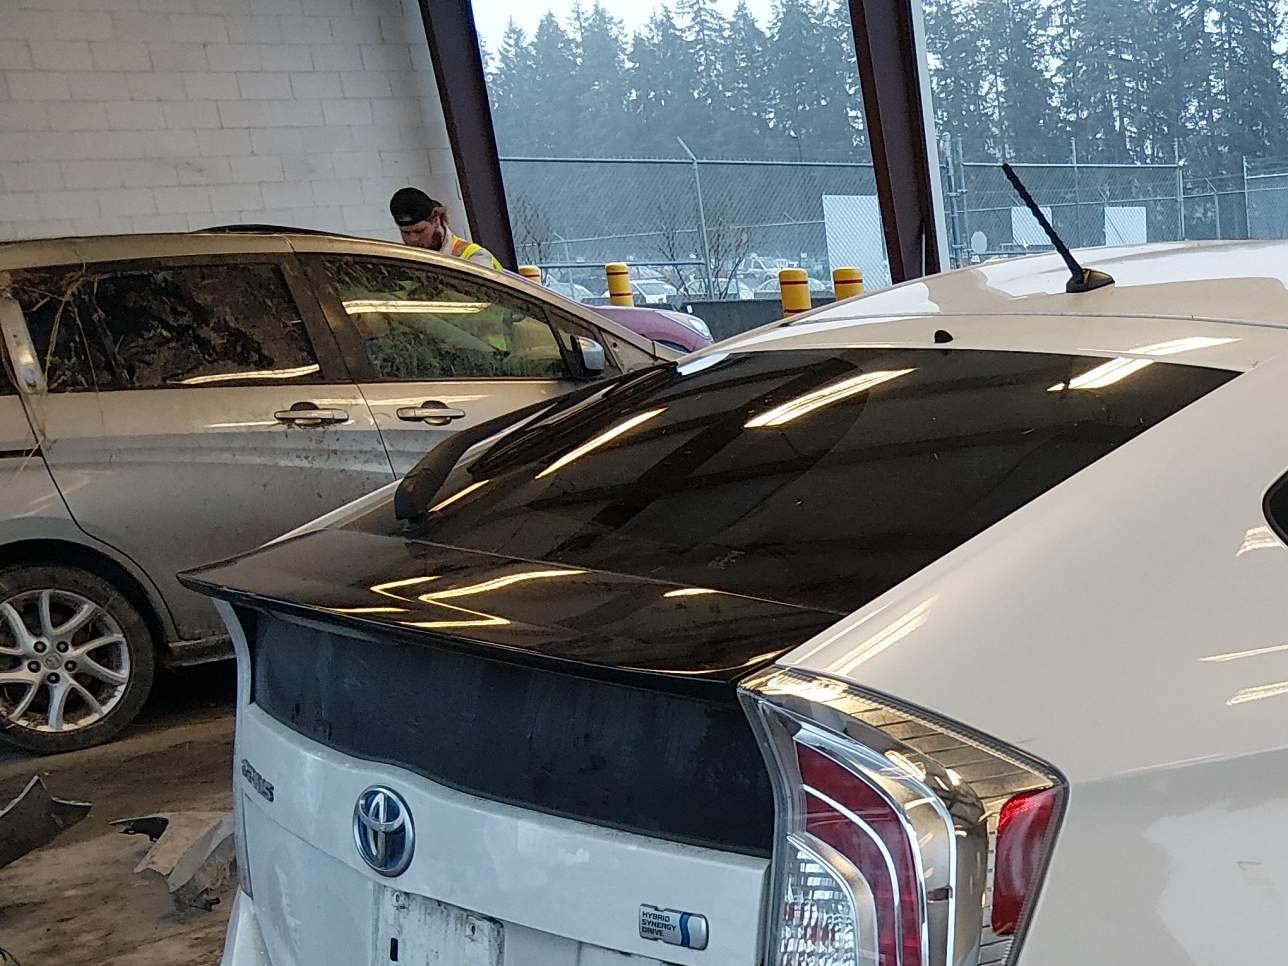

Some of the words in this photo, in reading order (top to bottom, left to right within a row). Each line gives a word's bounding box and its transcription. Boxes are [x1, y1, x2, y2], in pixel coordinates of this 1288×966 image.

[641, 911, 671, 923] HYBRID
[641, 918, 677, 931] SYNERGY
[641, 926, 665, 937] DRIVE
